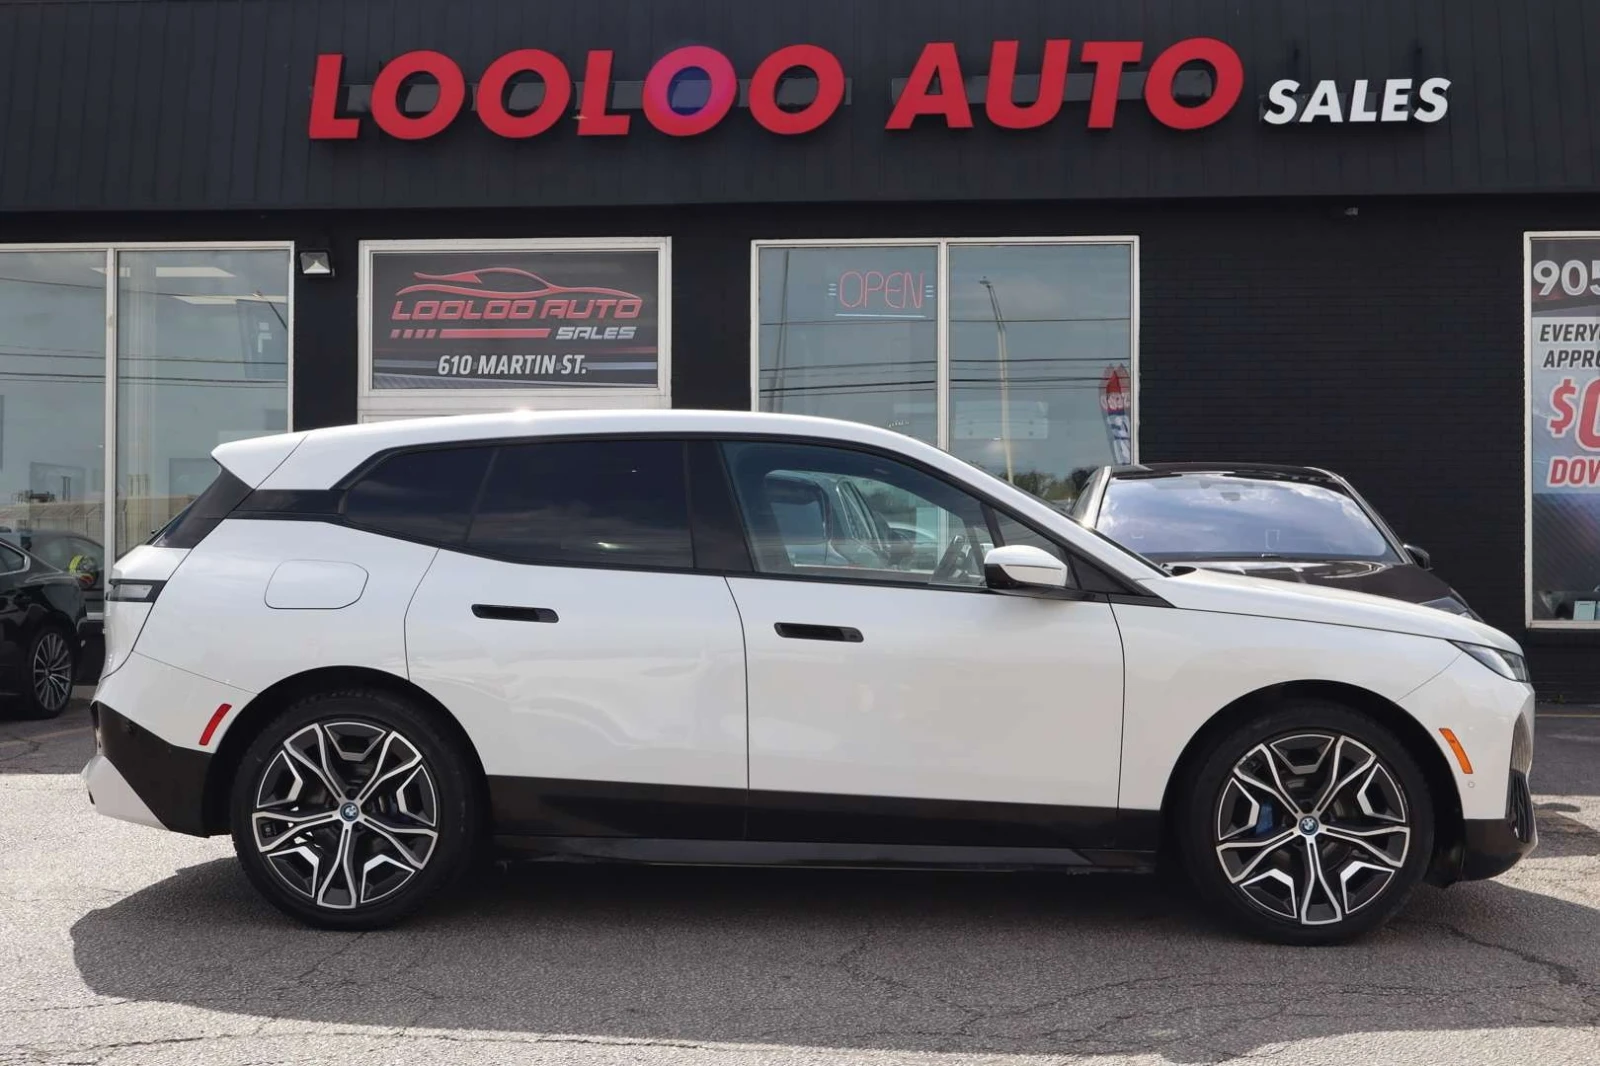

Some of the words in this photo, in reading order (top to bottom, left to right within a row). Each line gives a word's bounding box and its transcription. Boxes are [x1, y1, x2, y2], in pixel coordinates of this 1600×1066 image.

[309, 44, 845, 140] LOOLOO
[885, 38, 1244, 130] AUTO
[1263, 77, 1452, 125] SALES
[839, 271, 925, 309] OPEN
[391, 300, 536, 320] LOOLOO
[540, 300, 642, 319] AUTO
[555, 326, 637, 340] SALES
[1539, 324, 1600, 342] EVERY
[437, 354, 472, 375] 610
[477, 355, 556, 374] MARTIN
[560, 354, 587, 374] ST.
